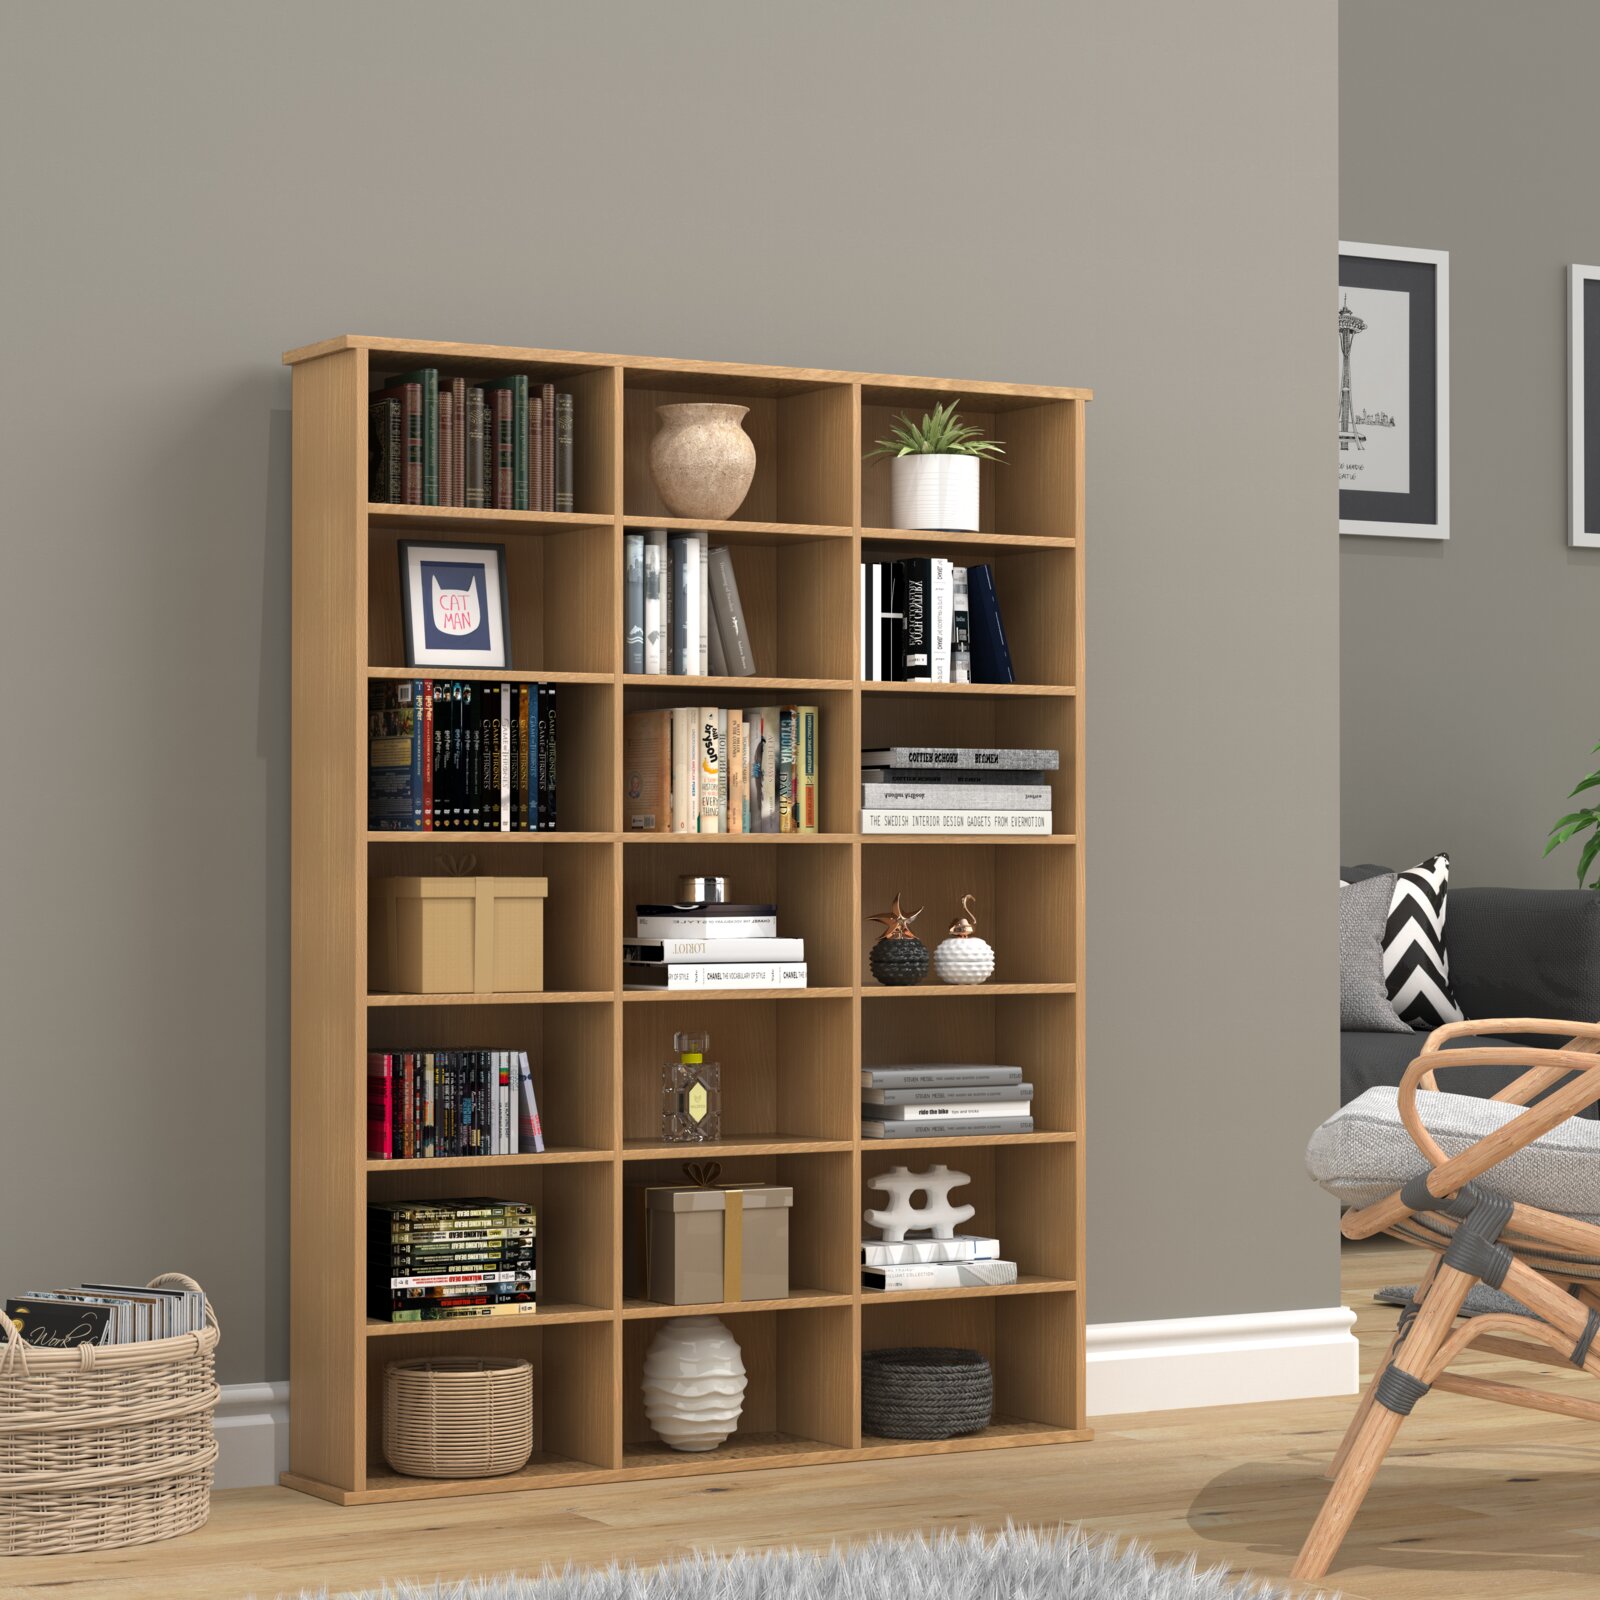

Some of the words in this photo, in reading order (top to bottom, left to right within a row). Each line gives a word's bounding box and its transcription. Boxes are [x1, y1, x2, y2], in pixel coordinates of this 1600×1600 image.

[439, 594, 470, 611] CAT
[443, 612, 472, 630] MAN
[482, 720, 490, 745] GAME
[492, 719, 500, 745] GAME
[538, 720, 546, 746] GAME
[702, 724, 718, 763] bryson
[780, 720, 792, 764] CYDONIA
[702, 796, 718, 806] EVERY
[778, 772, 788, 816] DAVID
[870, 815, 881, 827] THE
[884, 815, 909, 827] SWEDISH
[912, 815, 940, 827] INTERIOR
[943, 815, 964, 827] DESIGN
[967, 815, 991, 827] GADGETS
[994, 815, 1008, 827] FROM
[1011, 815, 1045, 827] EVERMOTION
[672, 944, 706, 954] LORIOT
[706, 972, 722, 980] CHANEL
[783, 971, 798, 979] CHANEL
[464, 1230, 487, 1238] WALKING
[466, 1241, 487, 1249] WALKING
[462, 1264, 483, 1272] WALKING
[30, 1323, 92, 1348] Work
